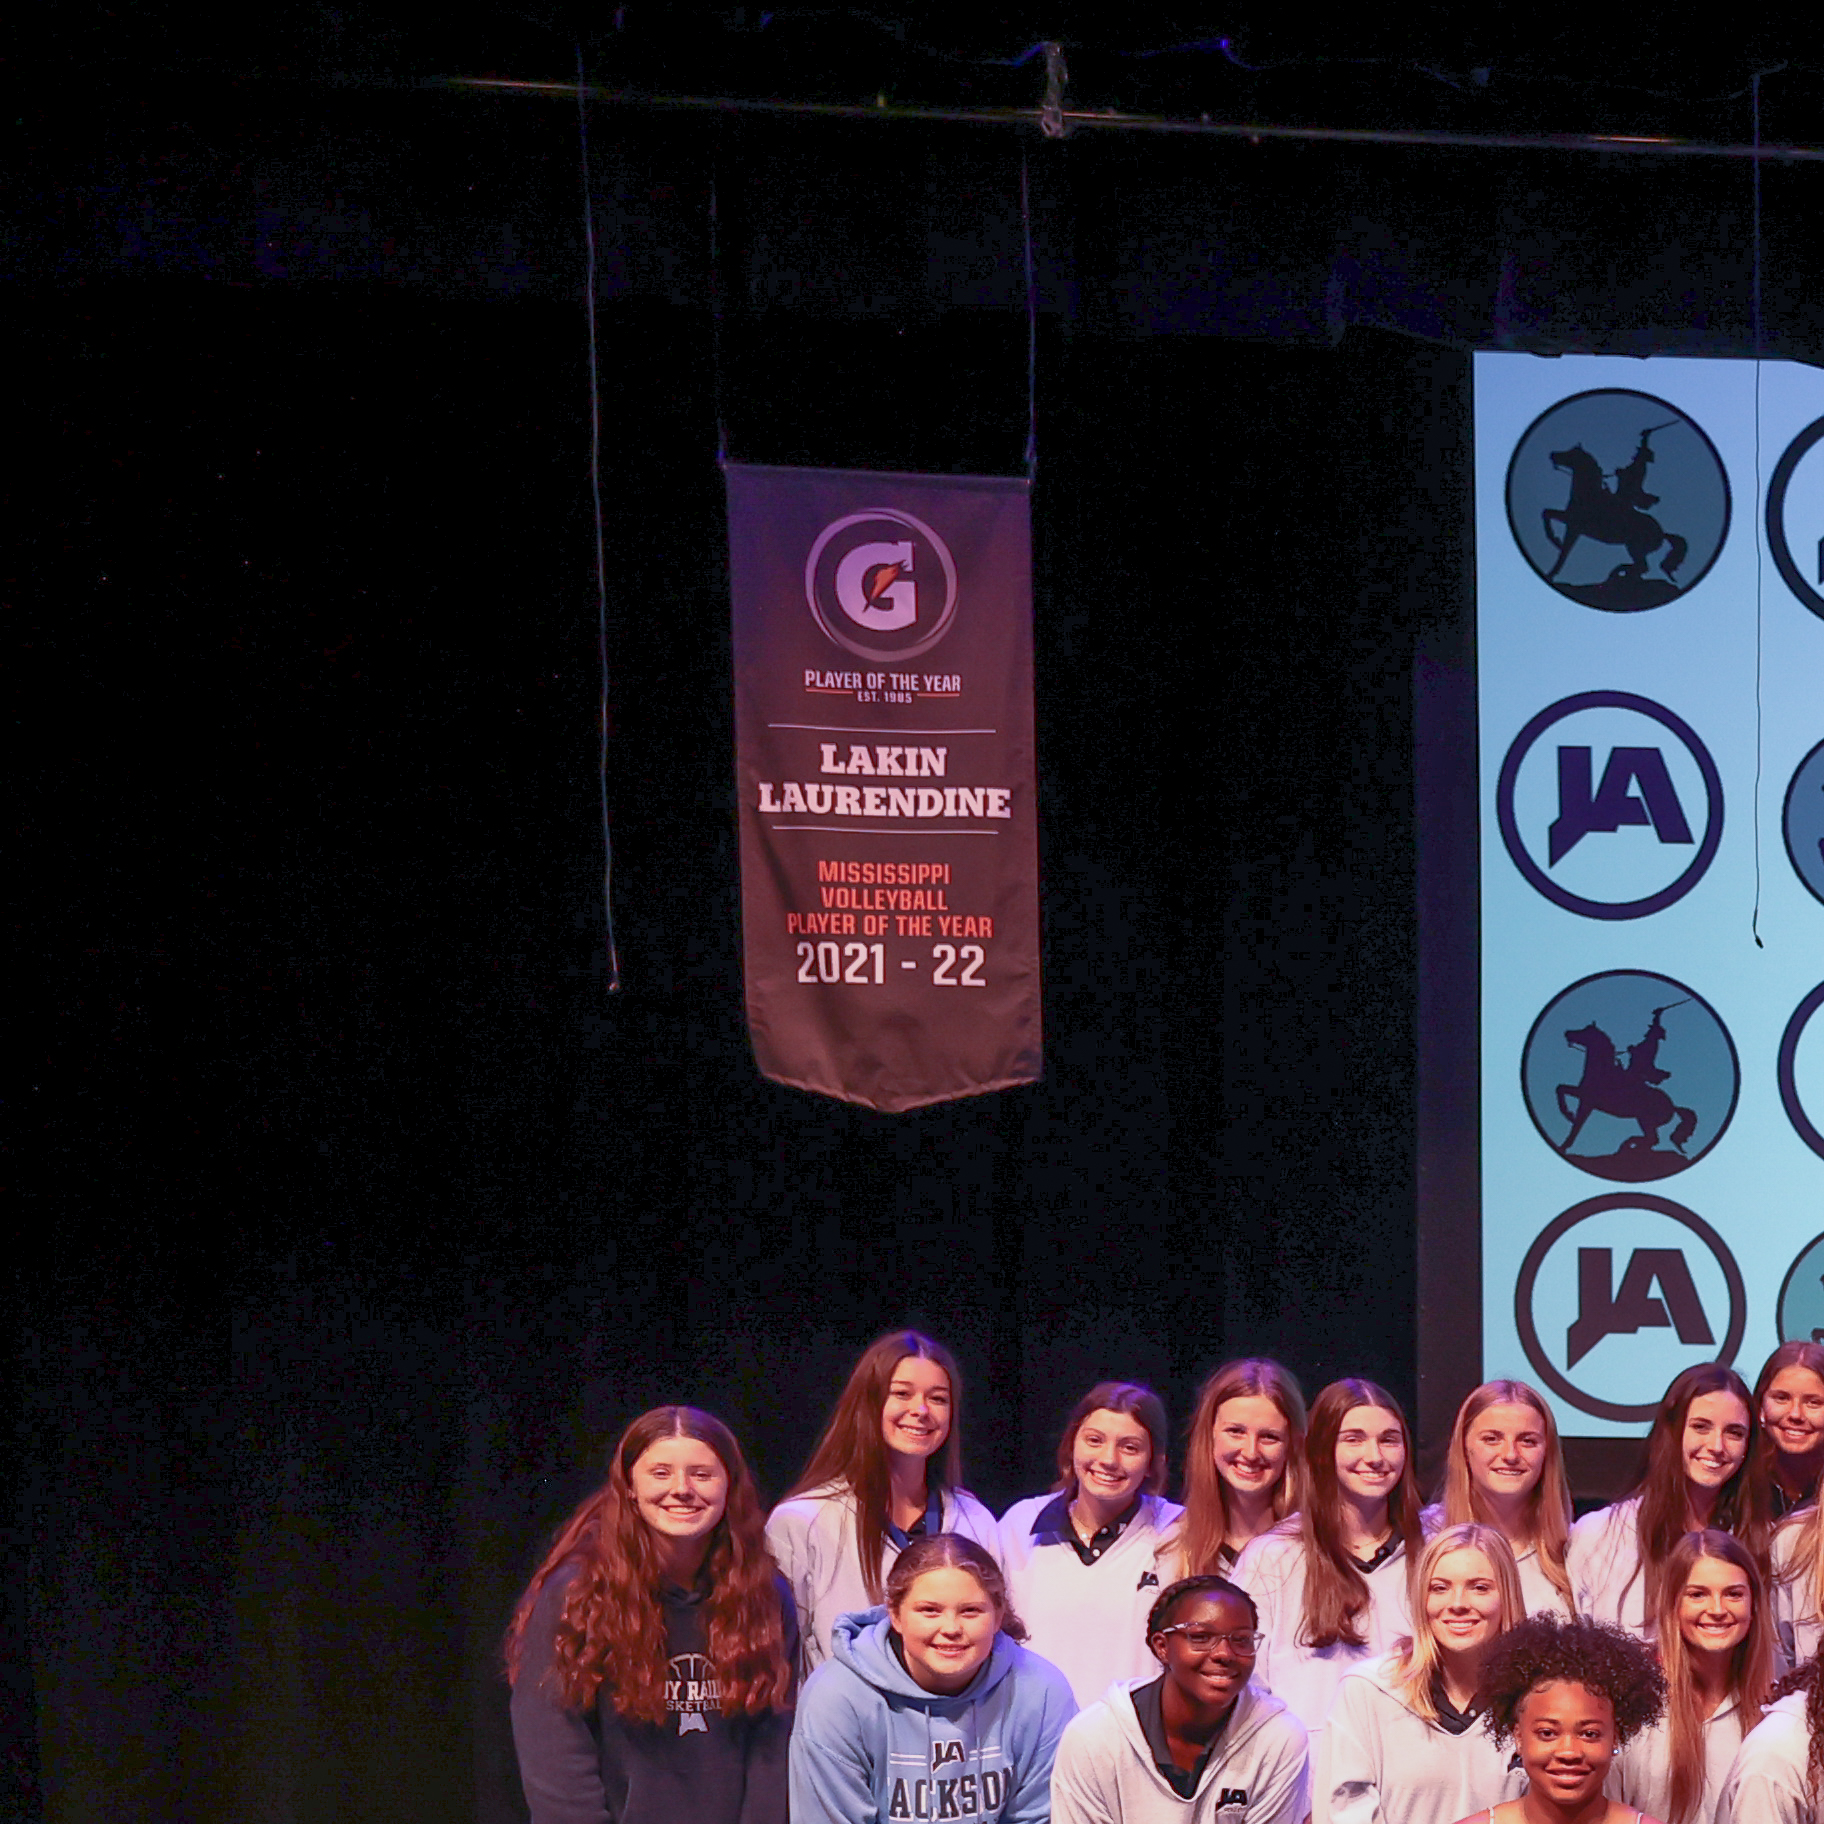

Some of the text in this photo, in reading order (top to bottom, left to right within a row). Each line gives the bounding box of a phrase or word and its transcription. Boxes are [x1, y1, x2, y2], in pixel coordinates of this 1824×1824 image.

[804, 669, 961, 692] PLAYER OF THE YEAR
[820, 744, 948, 777] LAKIN
[758, 782, 1012, 819] LAURENDINE
[1549, 745, 1695, 869] JA
[817, 860, 951, 885] MISSISSIPPI
[820, 887, 948, 911] VOLLEYBALL
[787, 913, 993, 939] PLAYER OF THE YEAR
[797, 941, 886, 985] 2021
[932, 944, 987, 987] 22
[1567, 1247, 1715, 1371] JA
[931, 1740, 966, 1774] JA
